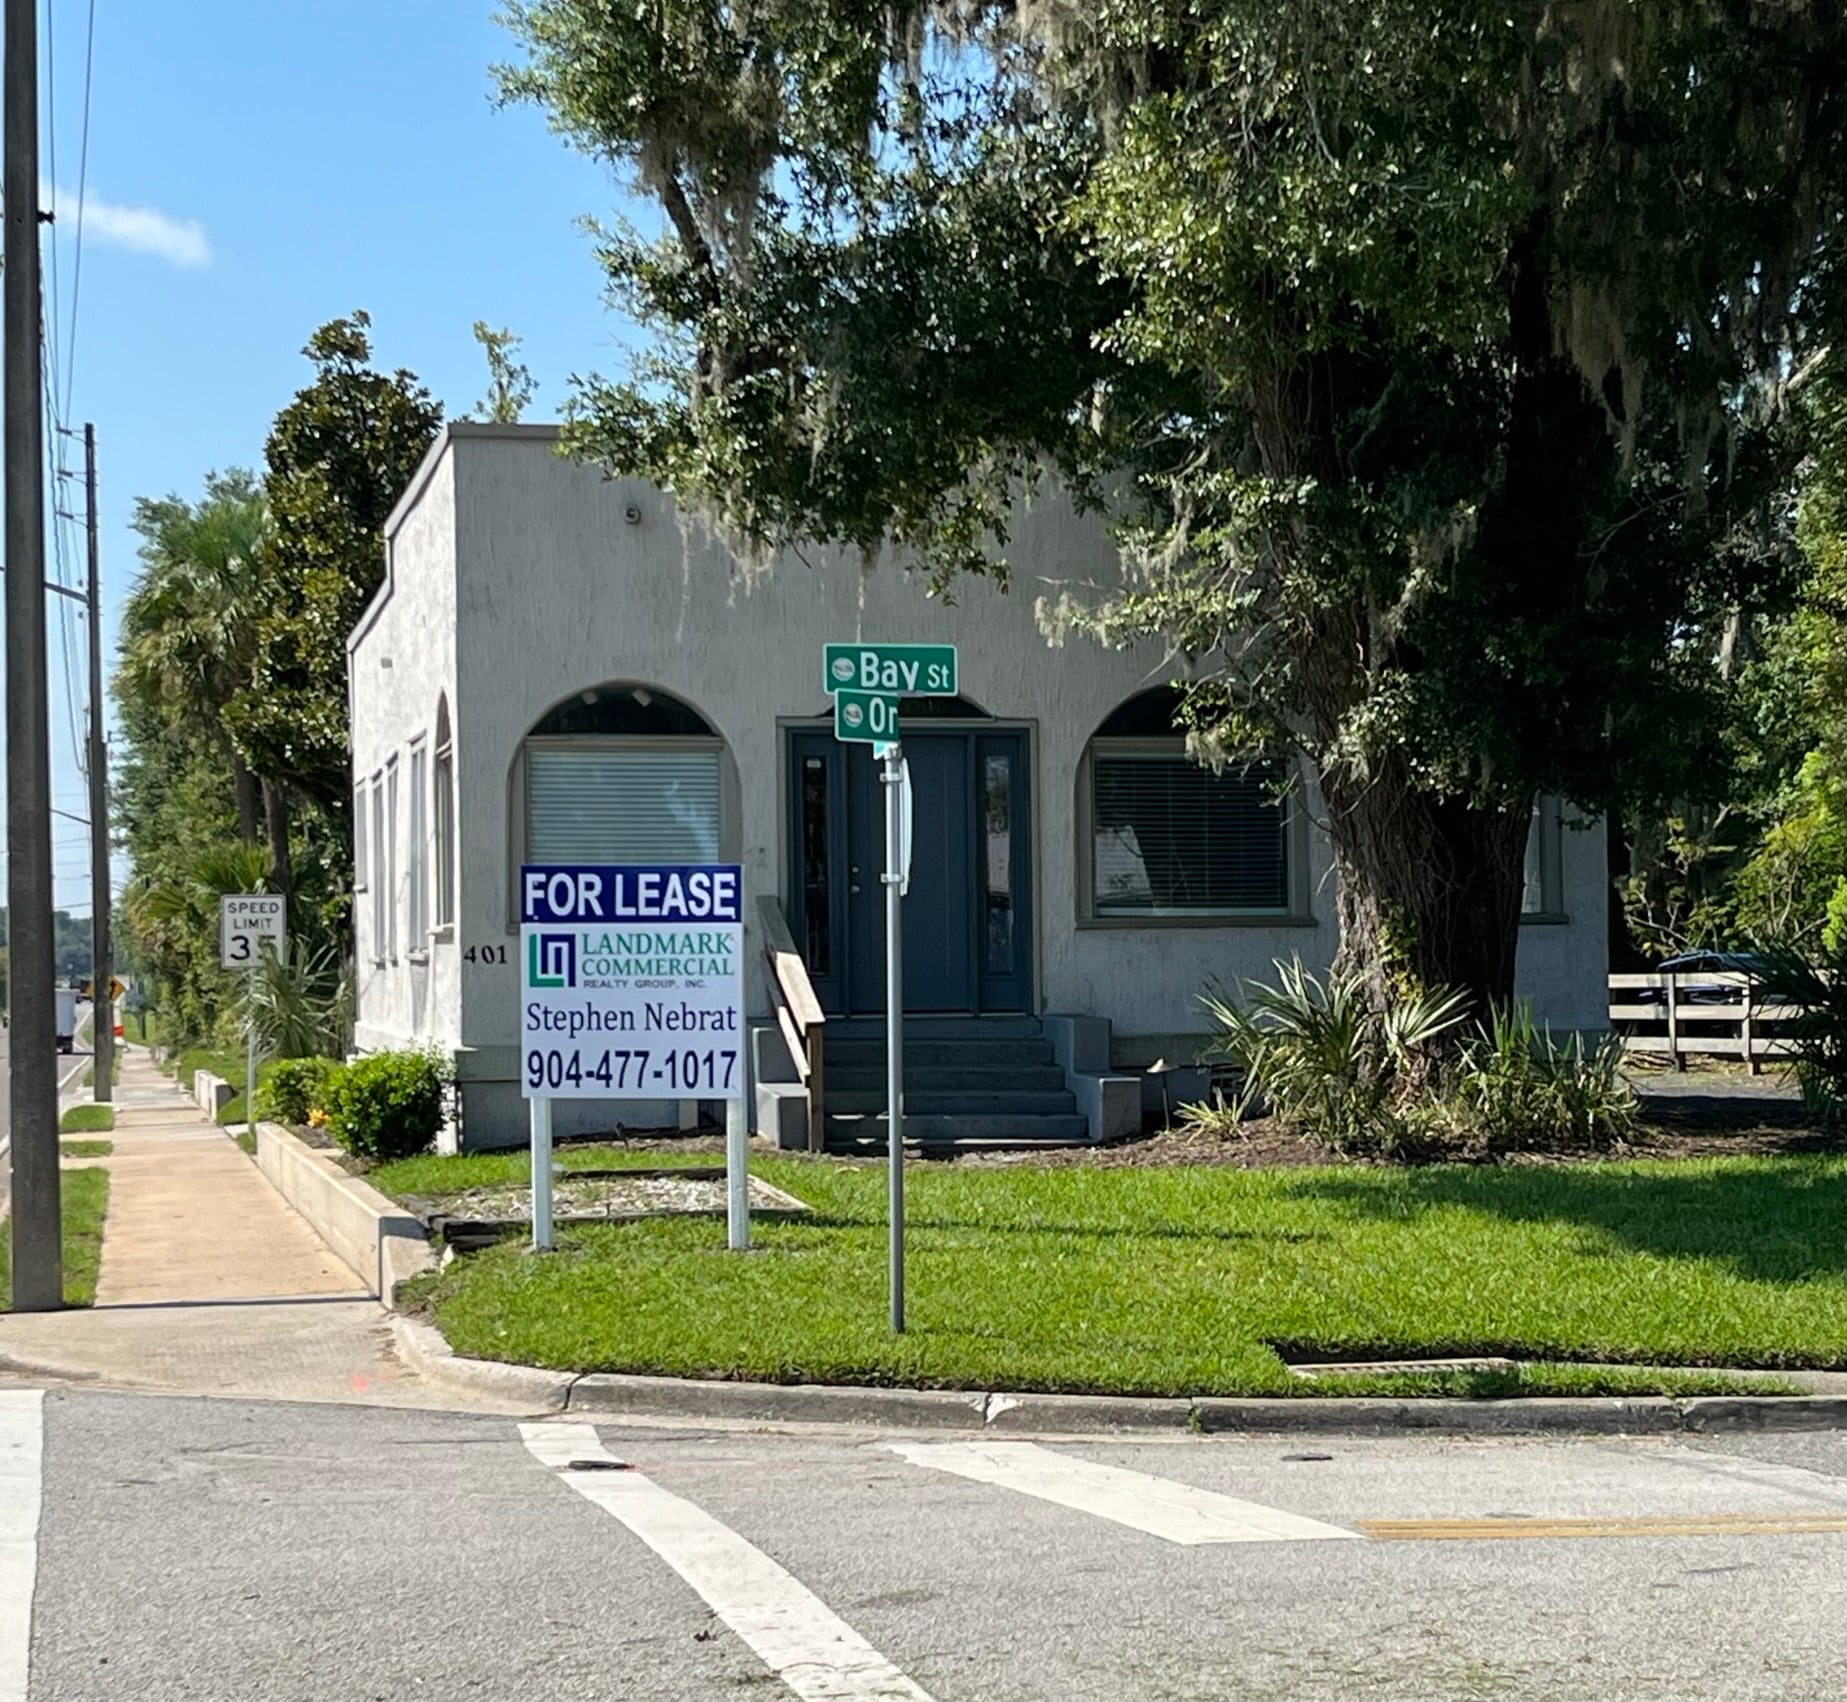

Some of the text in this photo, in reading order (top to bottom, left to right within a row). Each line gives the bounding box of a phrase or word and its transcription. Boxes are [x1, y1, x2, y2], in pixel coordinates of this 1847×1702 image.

[860, 651, 919, 691] Bay
[525, 873, 736, 917] FOR LEASE
[228, 902, 279, 914] SPEED
[233, 918, 274, 929] LIMIT
[582, 932, 733, 955] LANDMARK
[464, 945, 508, 965] 401
[582, 959, 734, 976] COMMERCIAL
[583, 979, 629, 989] REALTY
[527, 1002, 737, 1039] Stephen Nebrat
[528, 1050, 737, 1090] 904-477-1017
